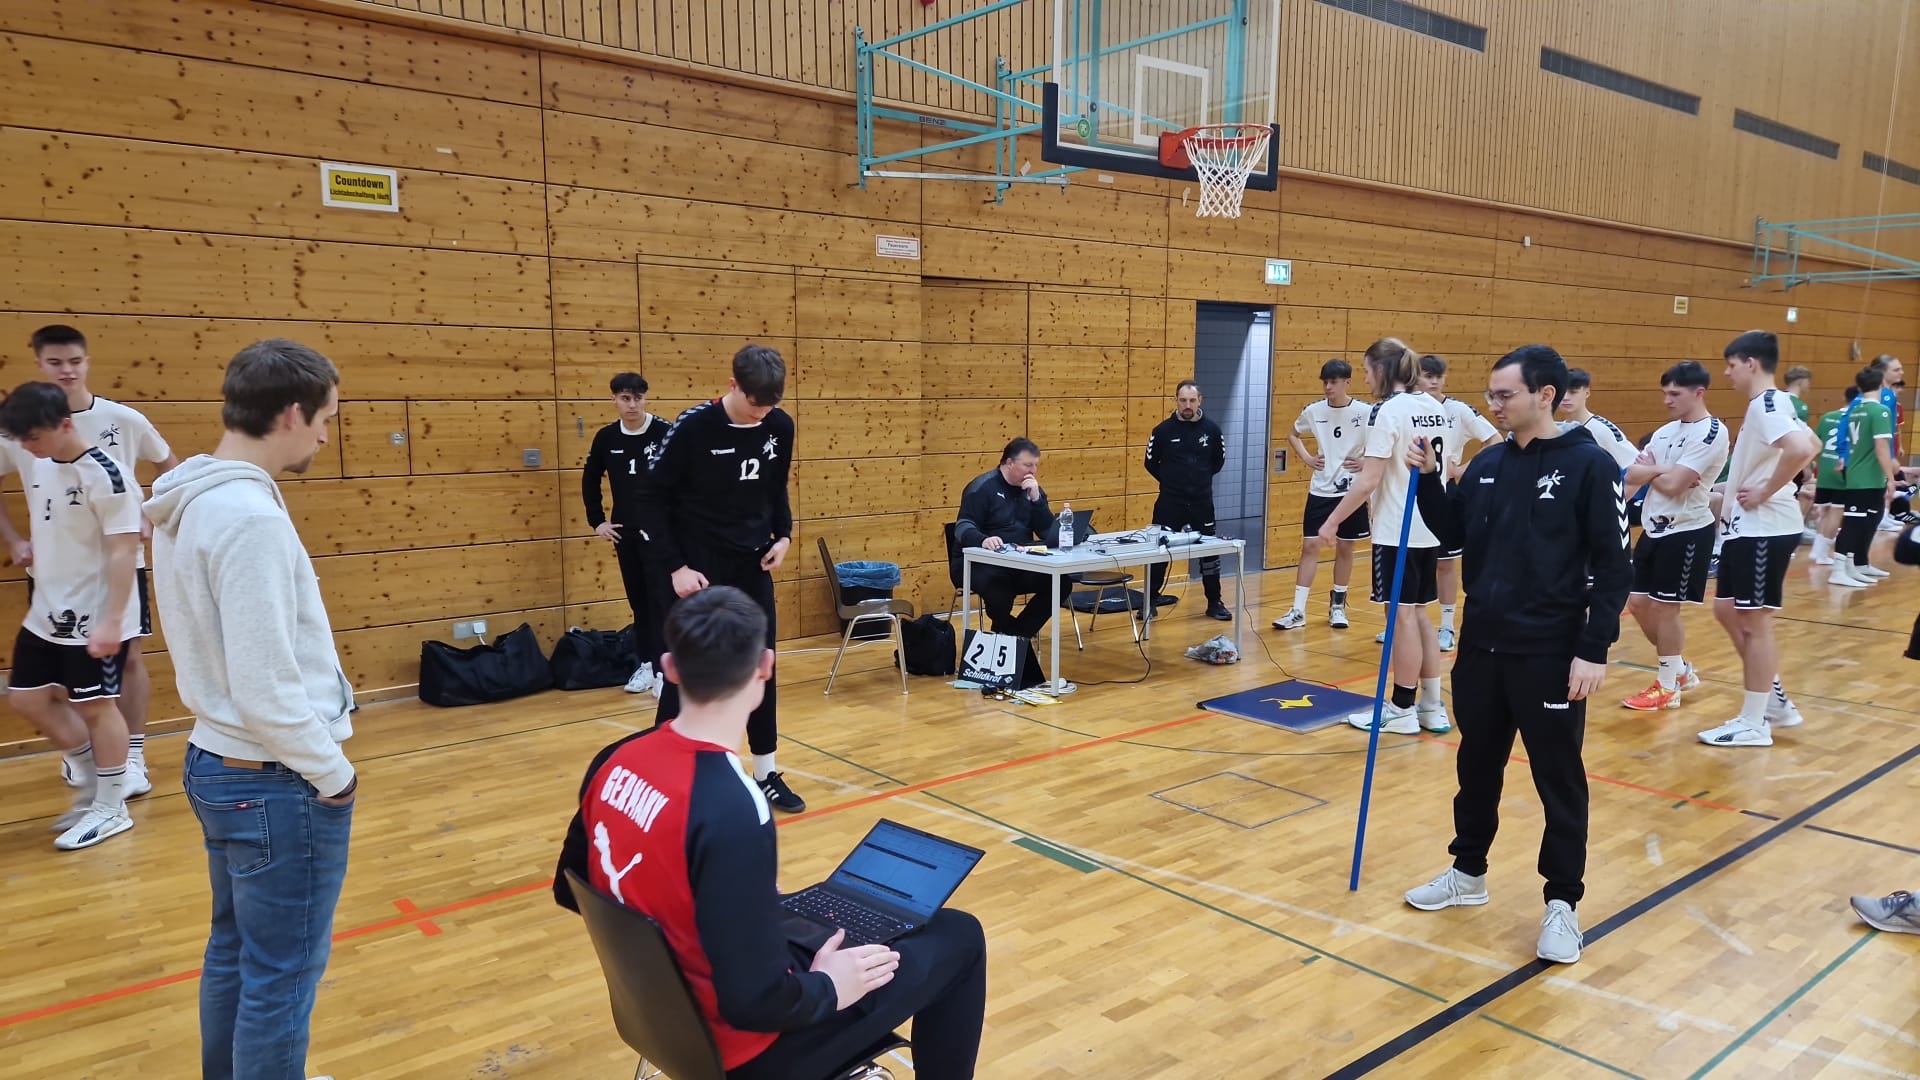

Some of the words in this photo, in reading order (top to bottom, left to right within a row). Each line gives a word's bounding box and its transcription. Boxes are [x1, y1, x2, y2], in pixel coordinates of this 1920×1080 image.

[919, 115, 946, 126] BENZ
[335, 174, 384, 189] Countdown
[1333, 426, 1342, 439] 6
[628, 458, 637, 475] 1
[739, 458, 760, 481] 12
[970, 643, 984, 665] 2
[997, 645, 1008, 668] 5
[600, 765, 670, 833] GERMANY
